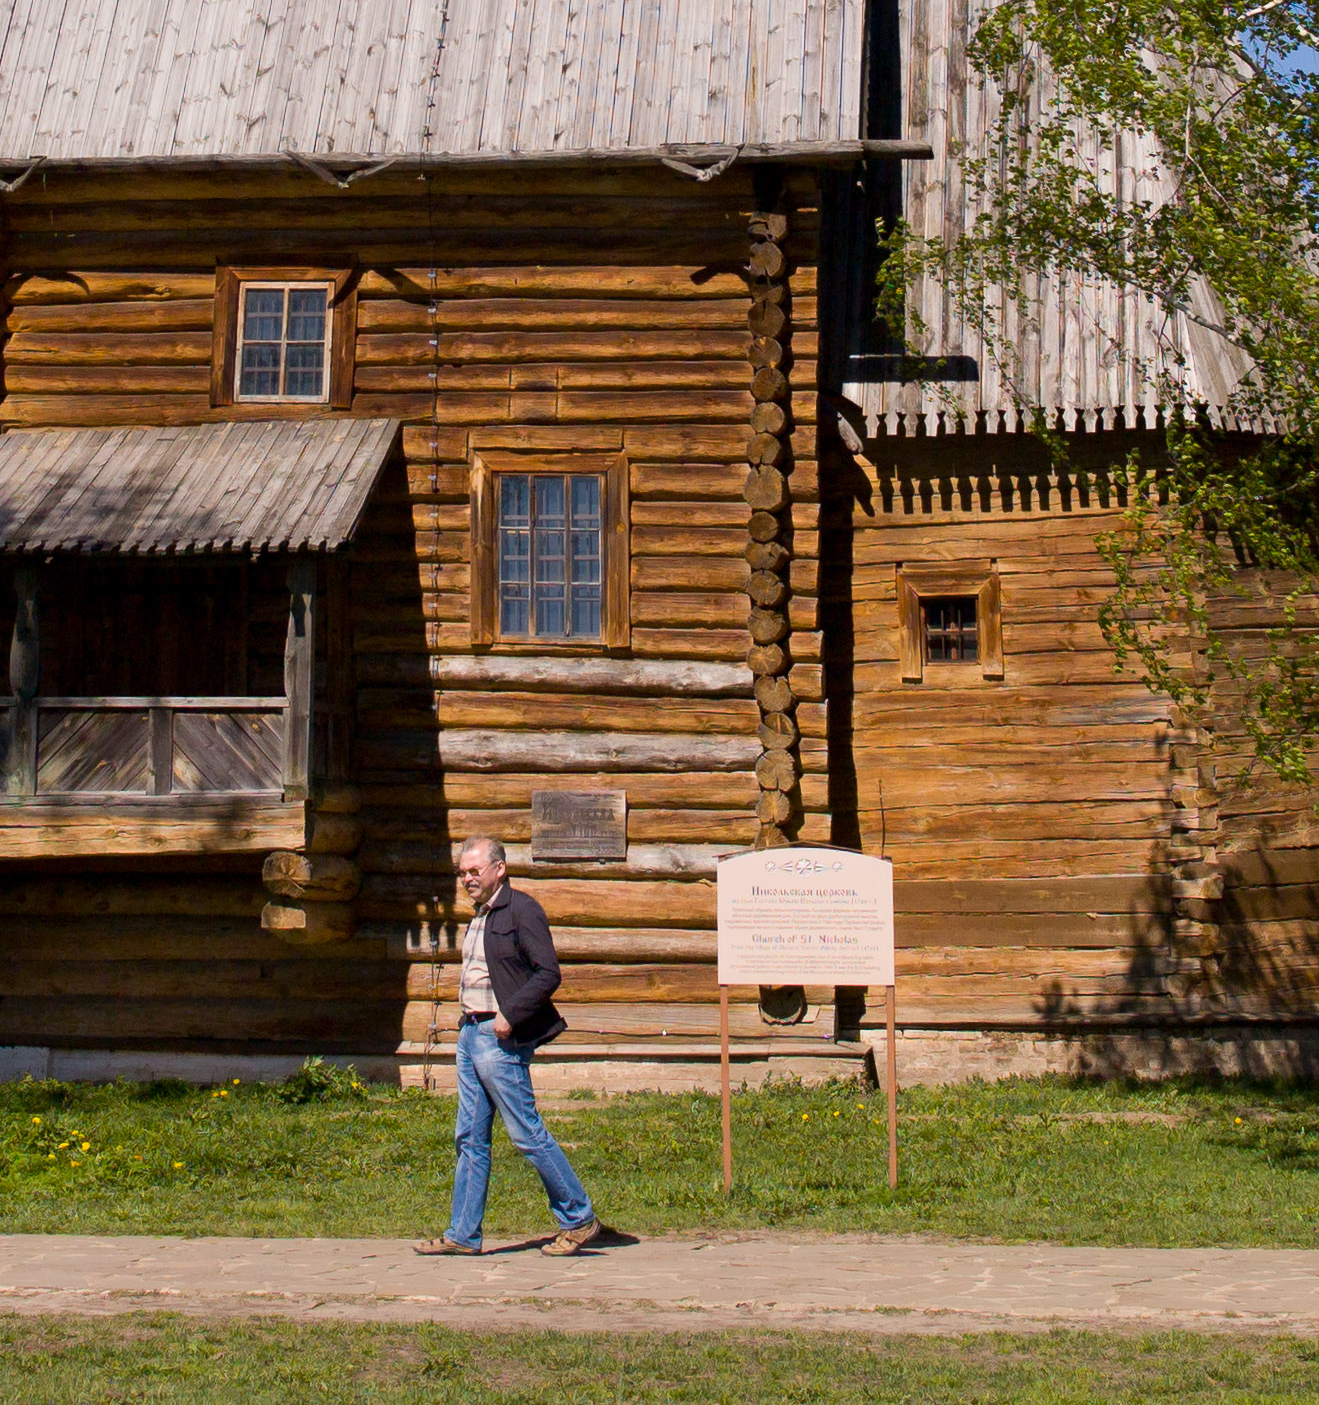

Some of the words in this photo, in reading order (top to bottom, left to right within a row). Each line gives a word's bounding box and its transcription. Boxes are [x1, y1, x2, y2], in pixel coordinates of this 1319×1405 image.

[752, 886, 813, 896] Никольская
[816, 888, 858, 898] церковь
[752, 934, 785, 943] Church
[787, 934, 797, 943] of
[819, 934, 859, 944] Nicholas
